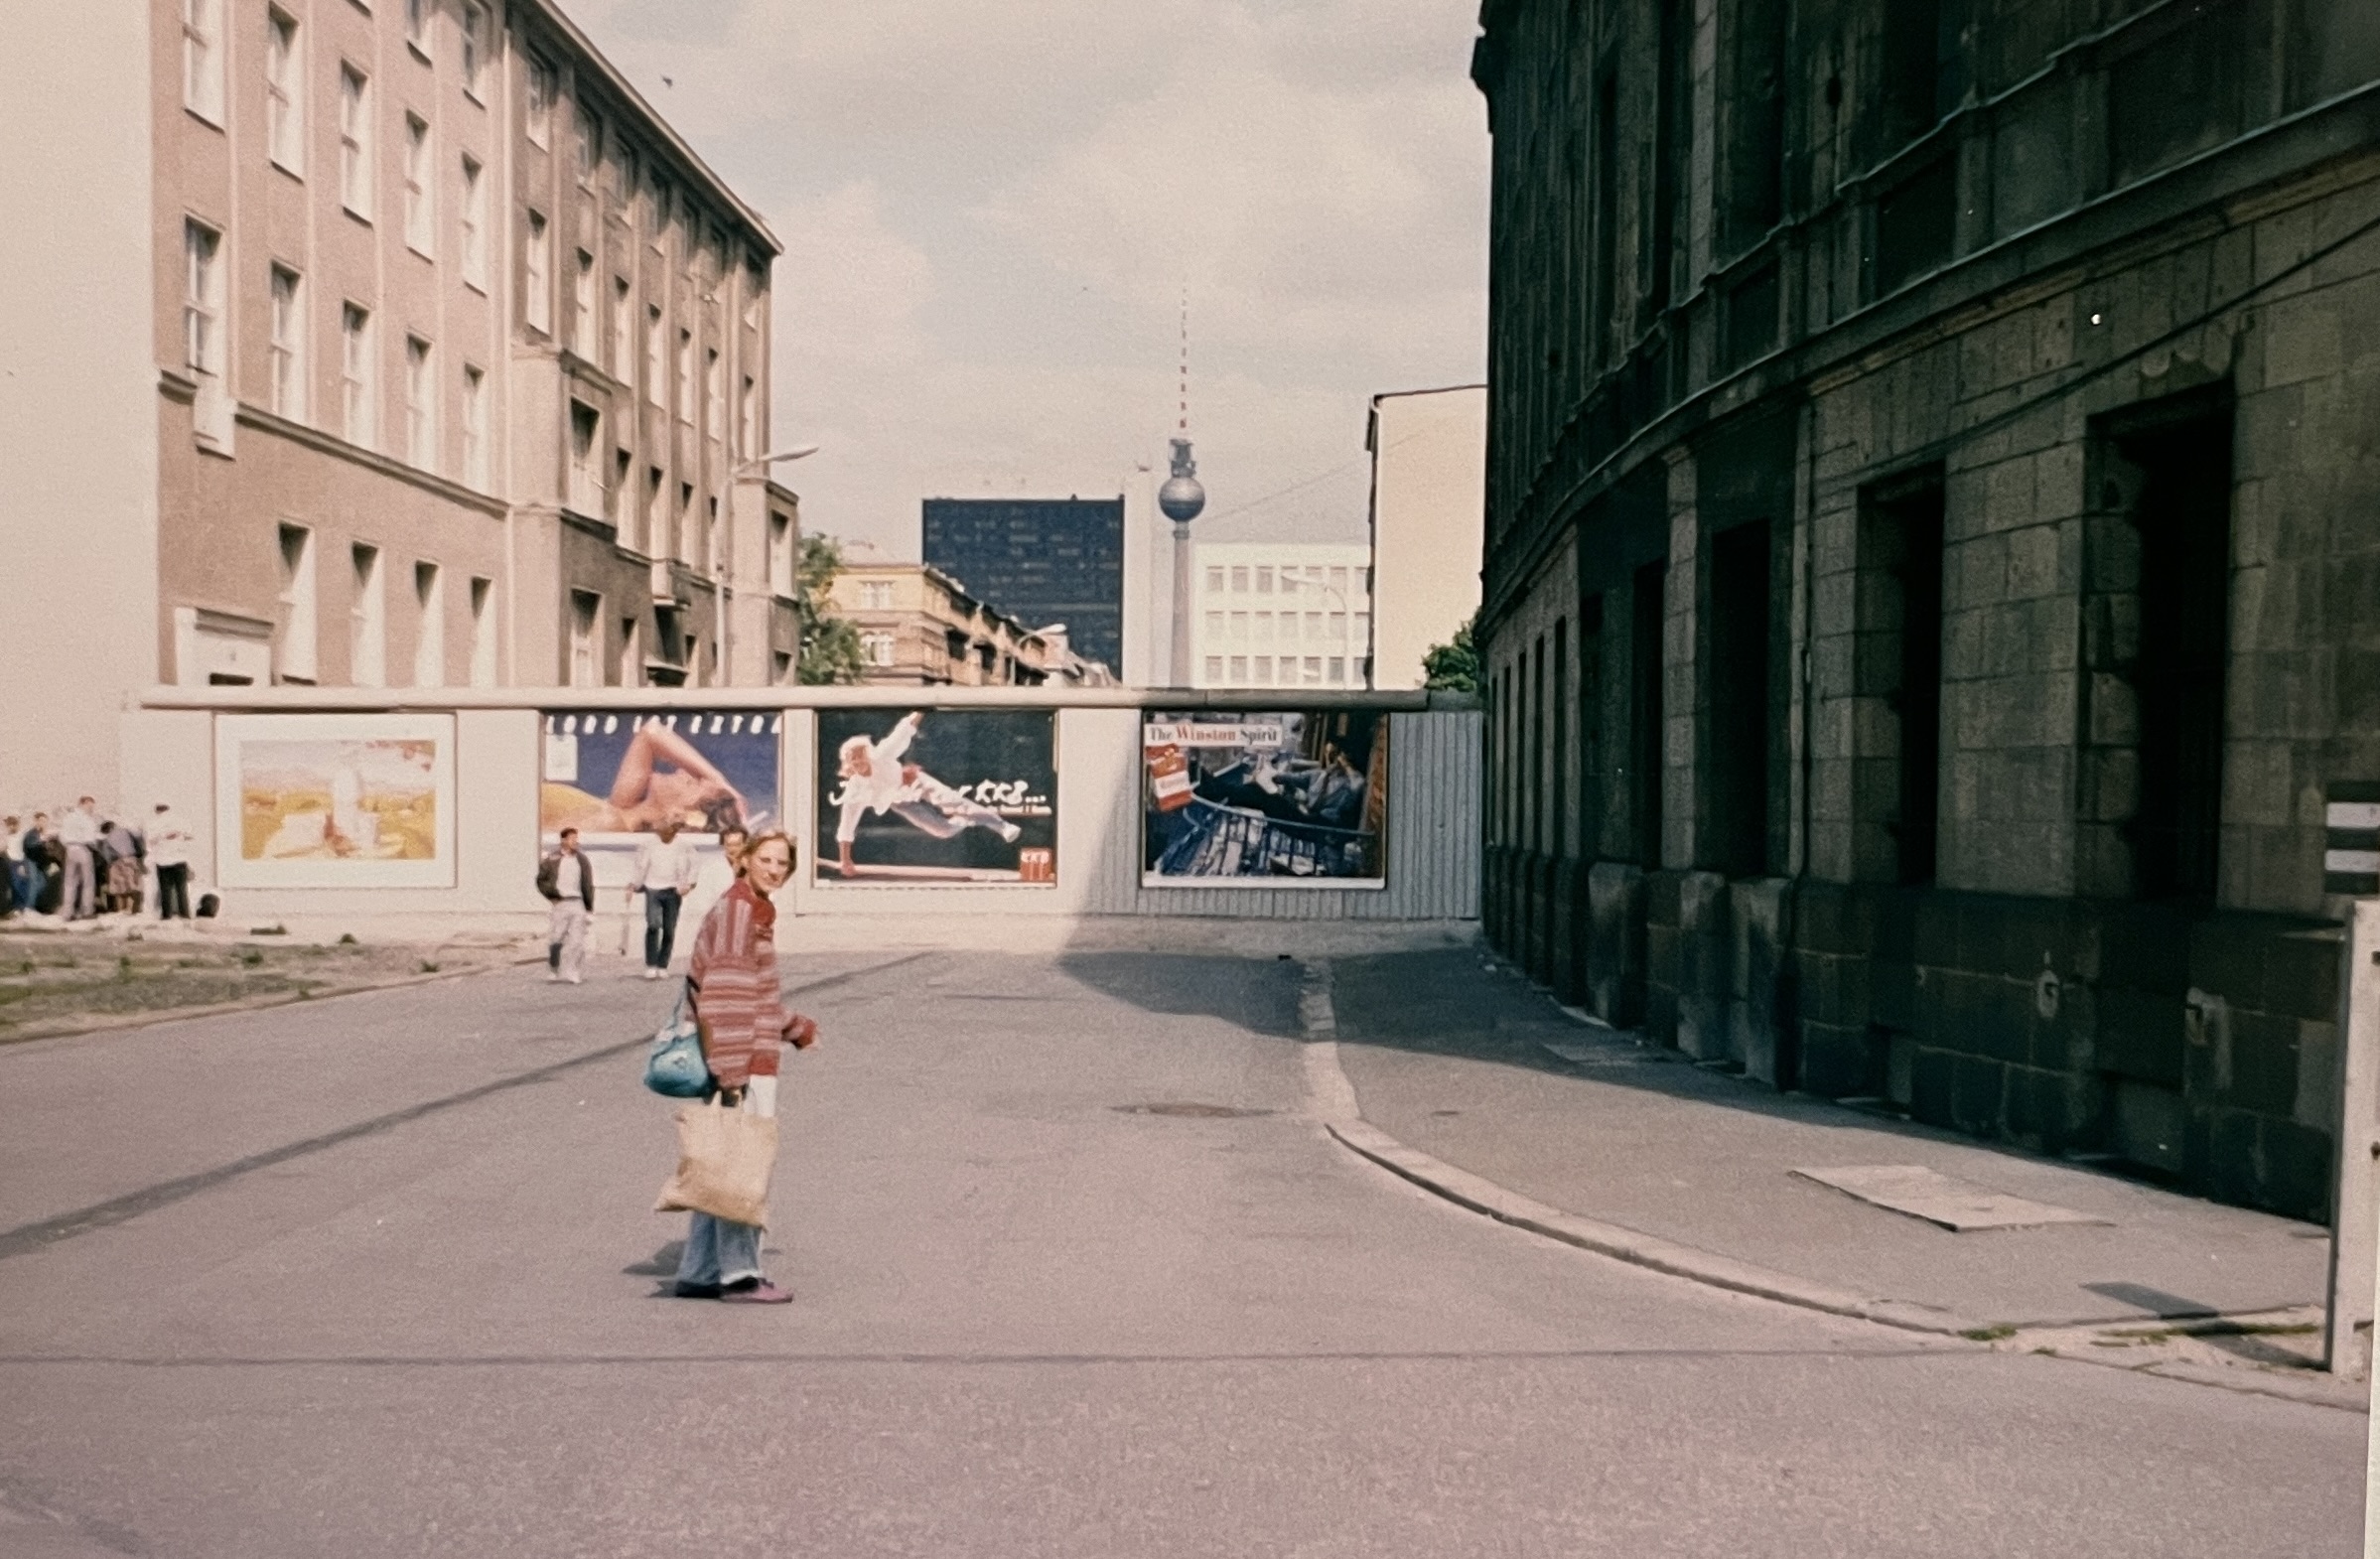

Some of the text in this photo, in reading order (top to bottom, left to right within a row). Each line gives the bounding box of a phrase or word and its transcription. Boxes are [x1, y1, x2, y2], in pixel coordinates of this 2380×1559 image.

[1150, 725, 1278, 745] The Winston Spirit
